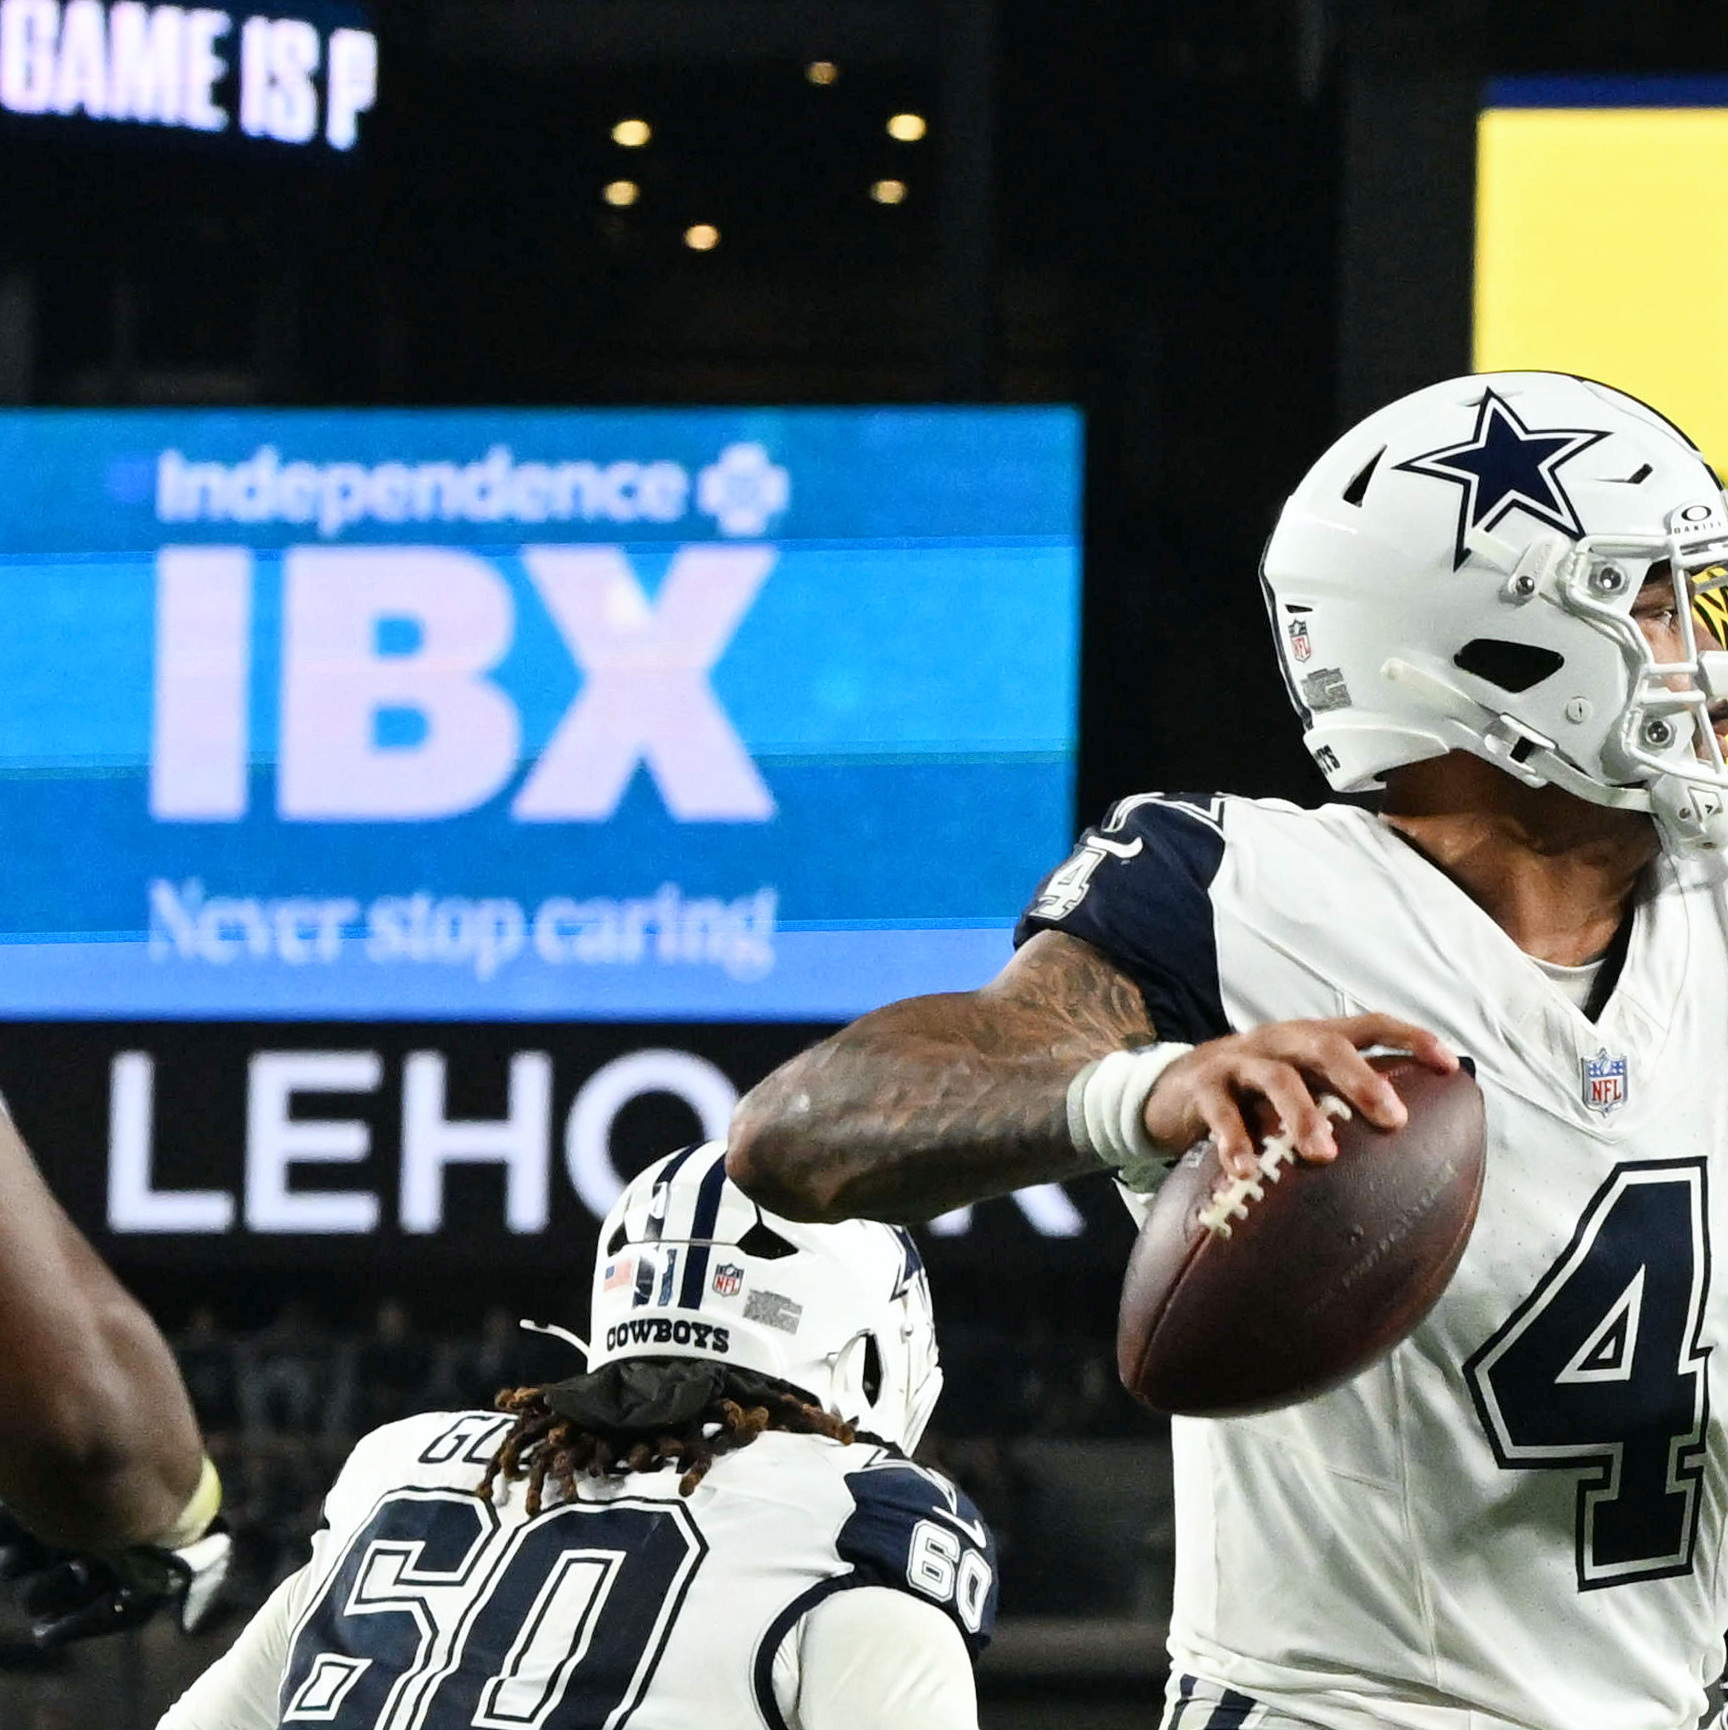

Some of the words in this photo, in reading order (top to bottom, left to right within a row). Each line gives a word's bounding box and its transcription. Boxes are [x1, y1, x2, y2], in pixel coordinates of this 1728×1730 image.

[0, 2, 230, 134] GAME
[239, 15, 318, 146] IS
[156, 443, 689, 539] Independence
[149, 543, 780, 824] IBX
[149, 877, 359, 965] Never
[366, 885, 525, 982] stop
[534, 879, 780, 983] caring
[1028, 846, 1107, 921] 4
[606, 1317, 730, 1354] COWBOYS
[1463, 1156, 1714, 1593] 4
[906, 1511, 994, 1635] 60
